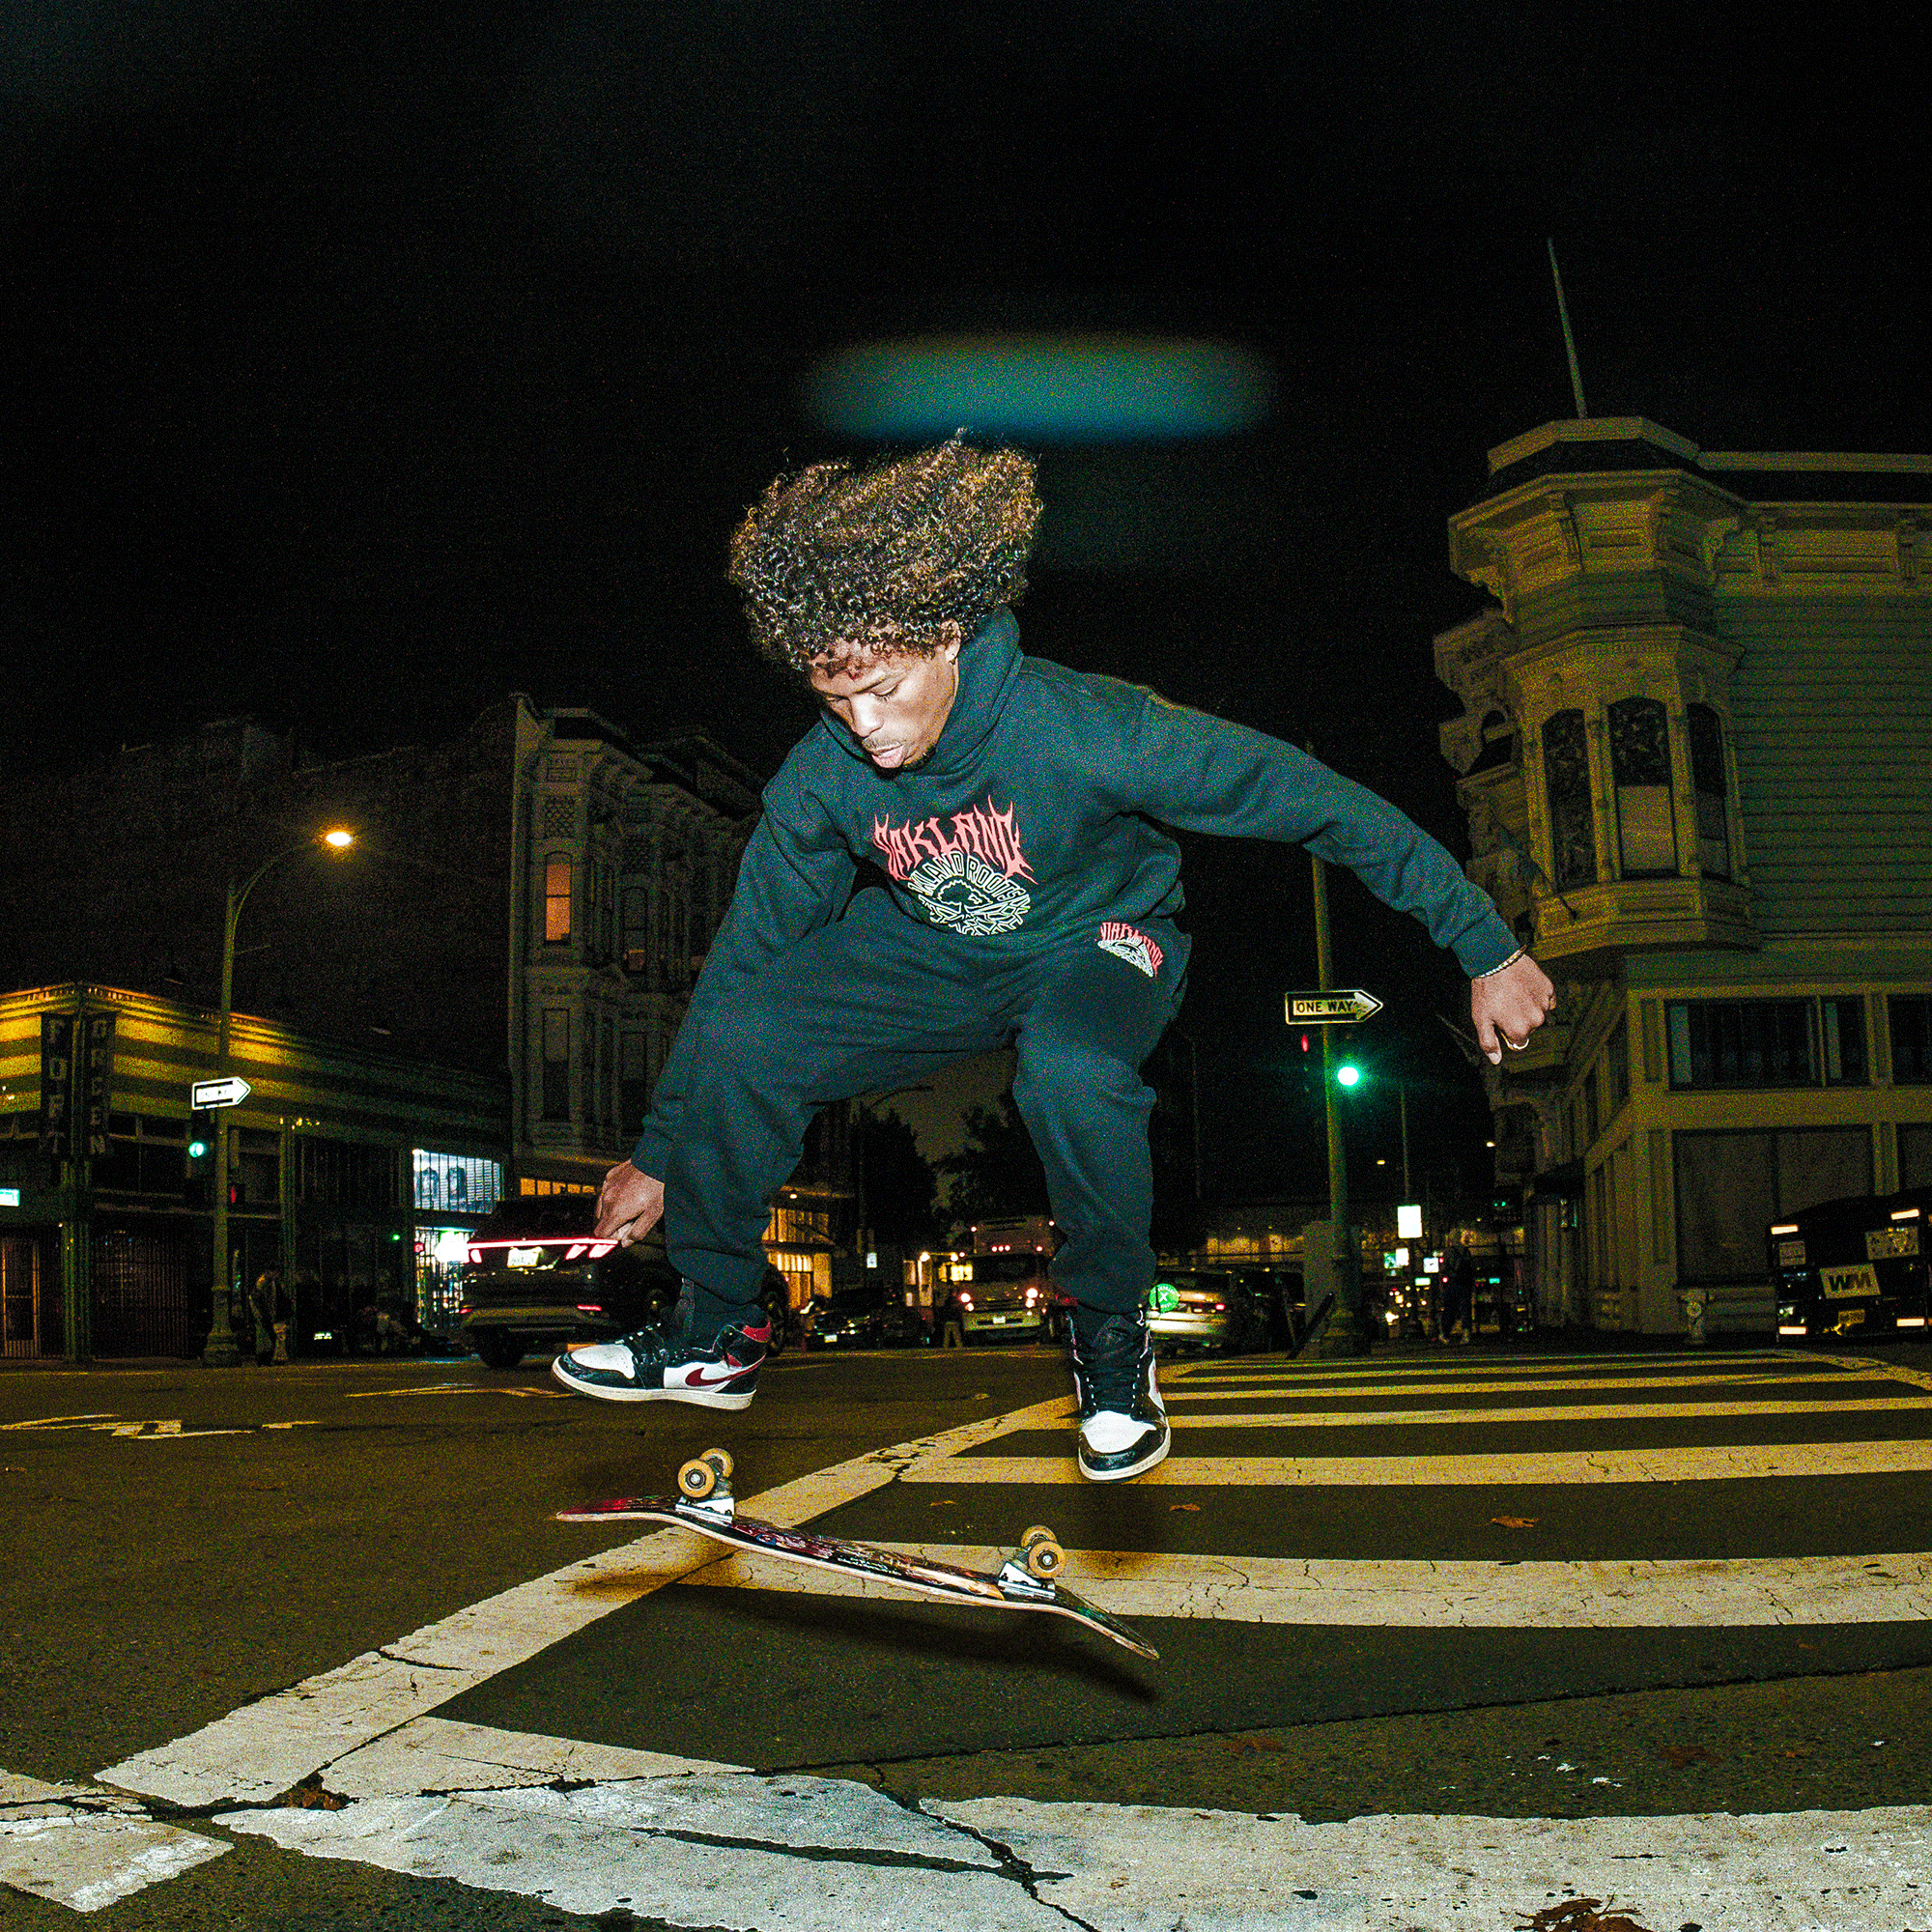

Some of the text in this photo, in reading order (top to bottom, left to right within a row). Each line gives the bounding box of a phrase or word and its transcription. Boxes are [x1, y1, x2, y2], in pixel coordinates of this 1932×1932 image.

[967, 856, 1027, 901] ROOTS
[1296, 1000, 1353, 1013] ONE WAY
[1828, 1271, 1872, 1293] WM
